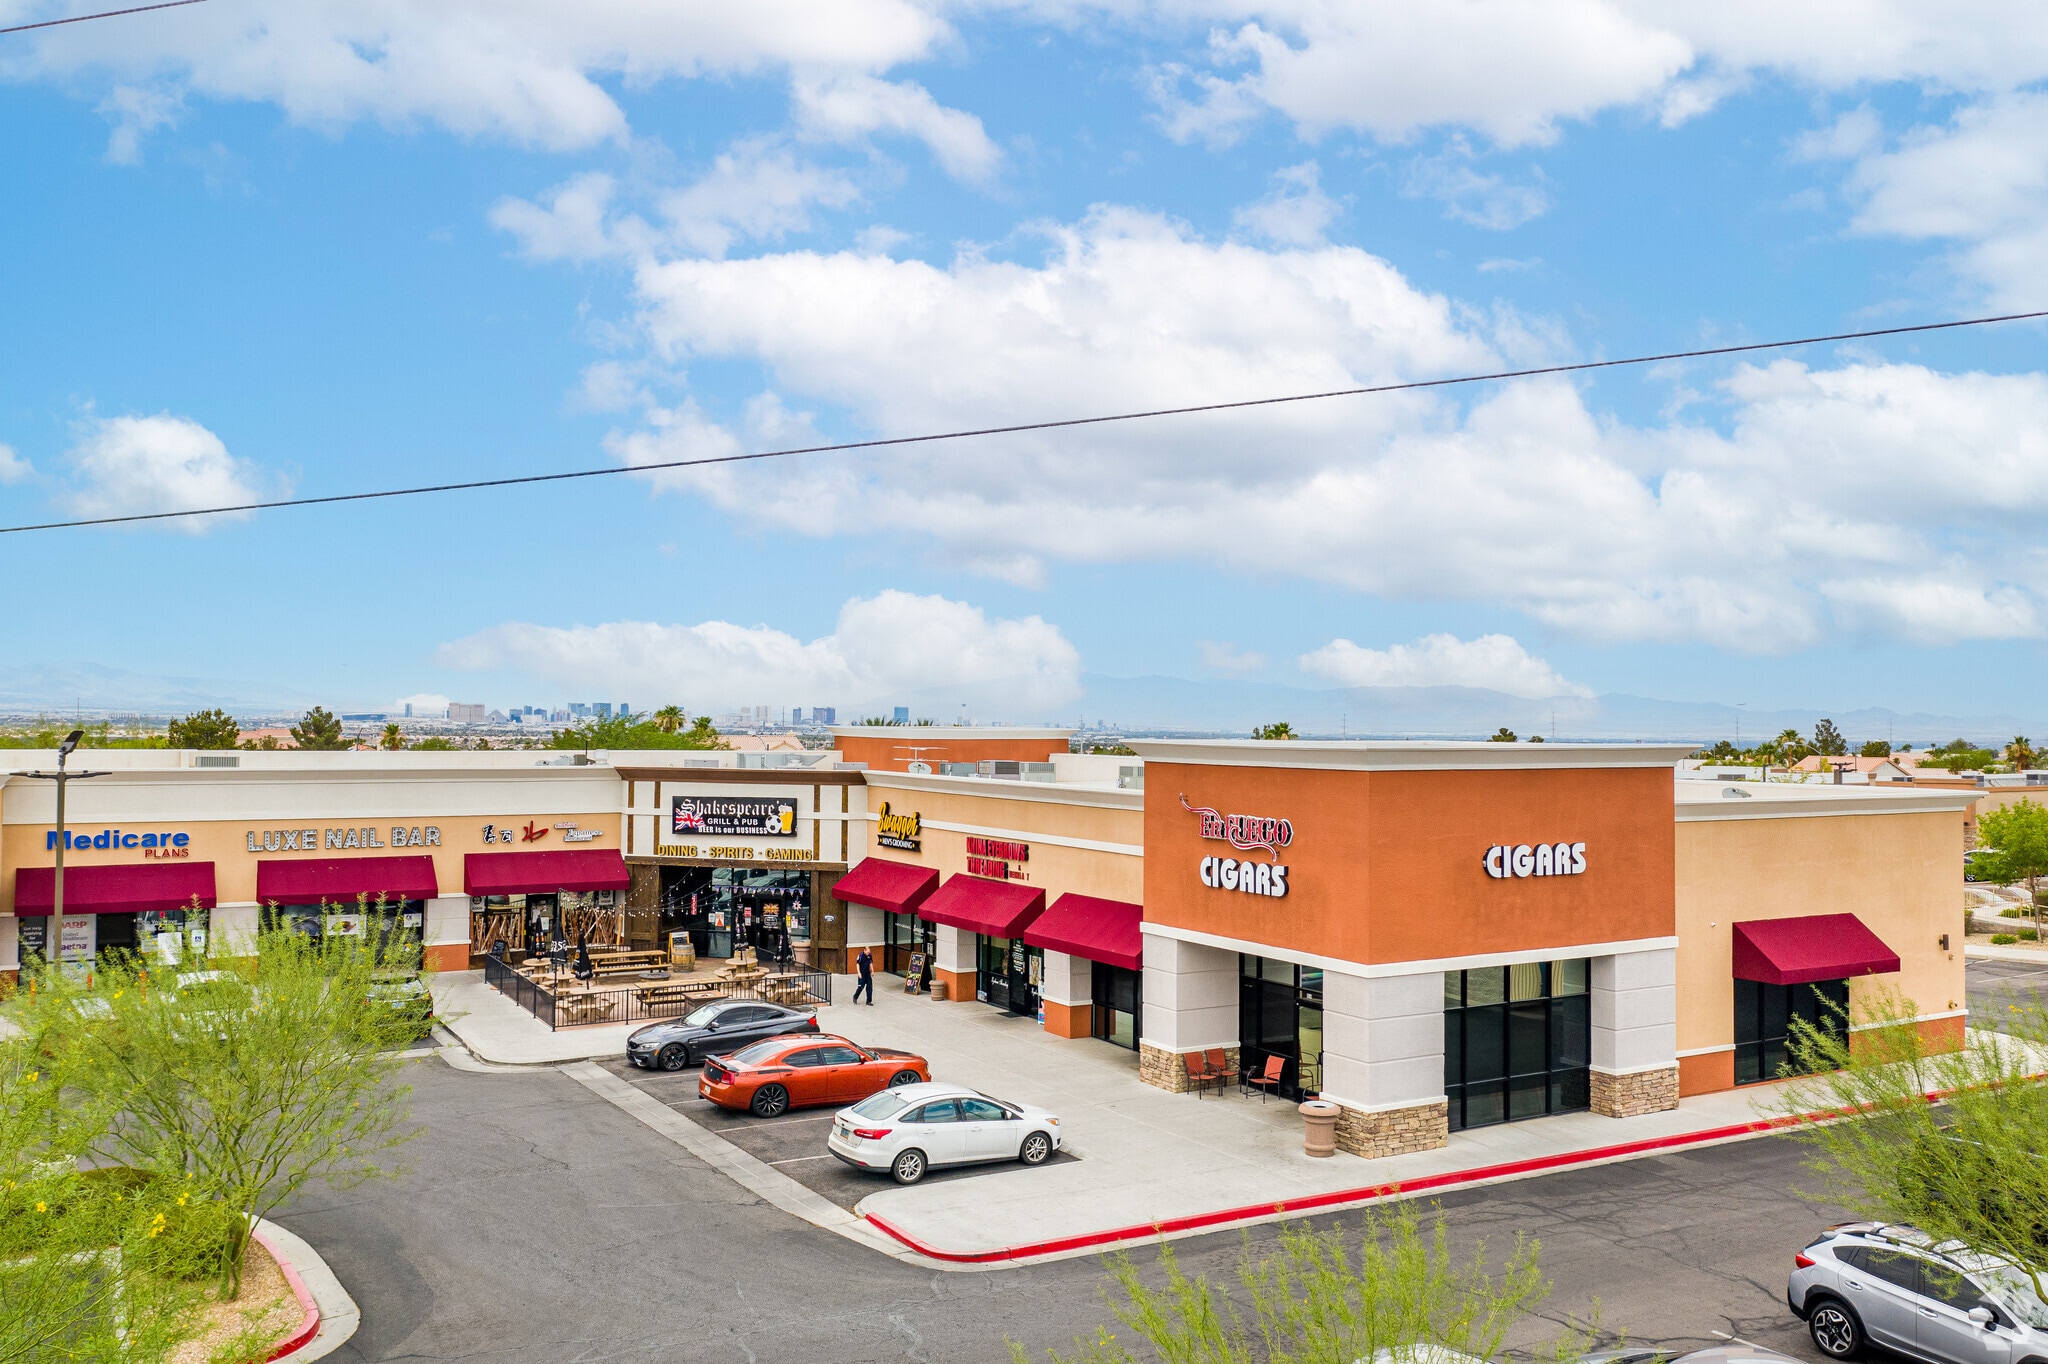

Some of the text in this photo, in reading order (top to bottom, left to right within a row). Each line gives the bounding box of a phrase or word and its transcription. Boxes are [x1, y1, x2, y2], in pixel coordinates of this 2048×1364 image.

[707, 817, 731, 825] GRILL
[741, 818, 759, 826] PUB
[736, 827, 768, 835] BUSINESS
[46, 829, 190, 851] Medicare
[247, 826, 441, 852] LUXE NAIL BAR
[144, 848, 190, 858] PLANS
[657, 845, 697, 857] DINING
[709, 846, 753, 859] SPIRITS
[765, 848, 812, 861] GAMING
[987, 839, 1029, 862] EYEBROWS
[1483, 842, 1587, 878] CIGARS
[967, 856, 1008, 879] THREADING
[1200, 855, 1289, 897] CIGARS
